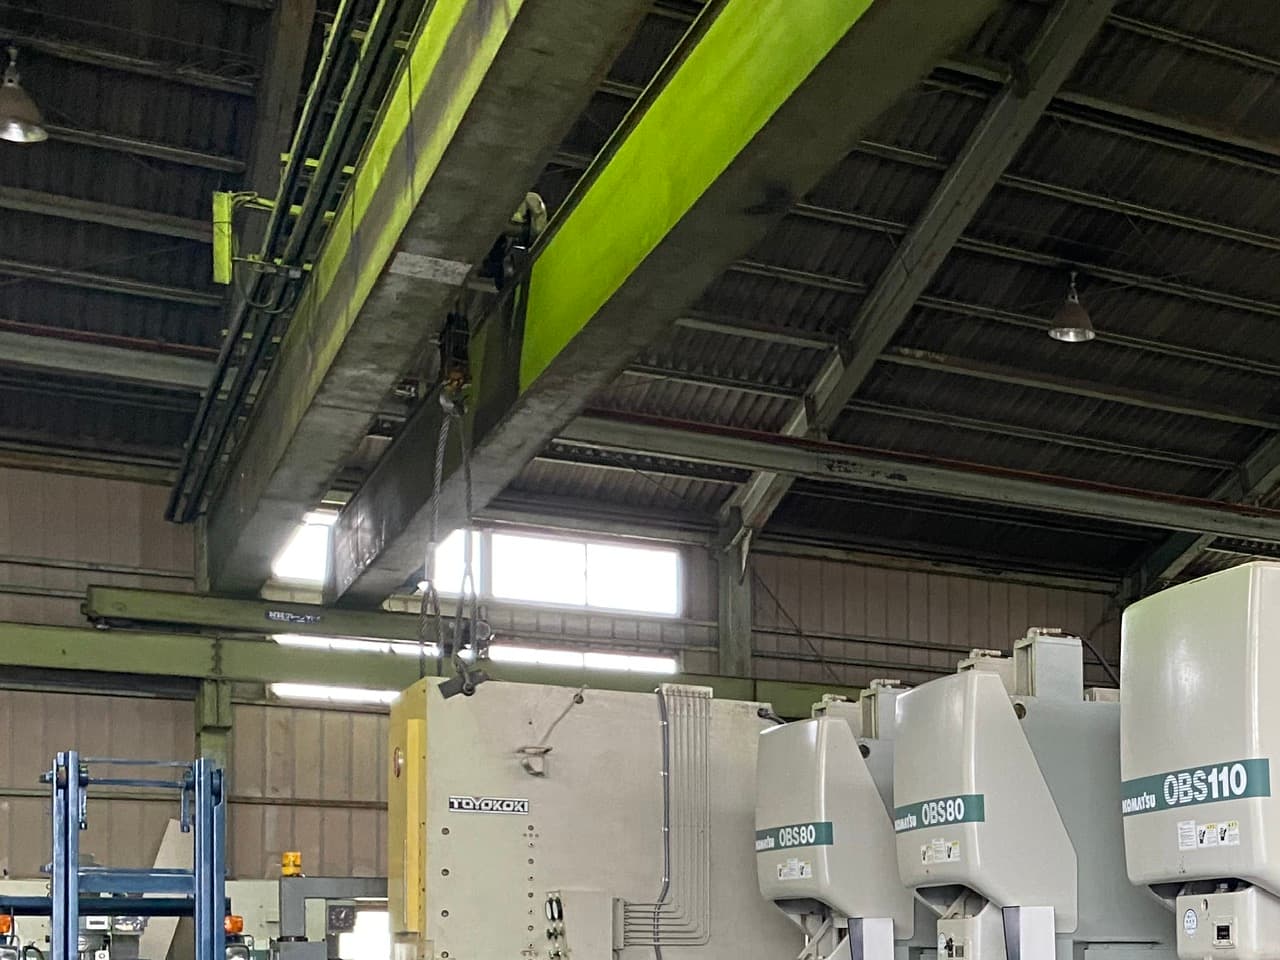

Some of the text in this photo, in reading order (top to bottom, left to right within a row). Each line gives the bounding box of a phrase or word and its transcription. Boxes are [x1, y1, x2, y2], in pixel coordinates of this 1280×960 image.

[1122, 763, 1247, 813] KOMATSU OBS110
[449, 797, 528, 812] TOYOKOKI
[921, 798, 964, 825] OBS80
[779, 825, 815, 847] OBS80
